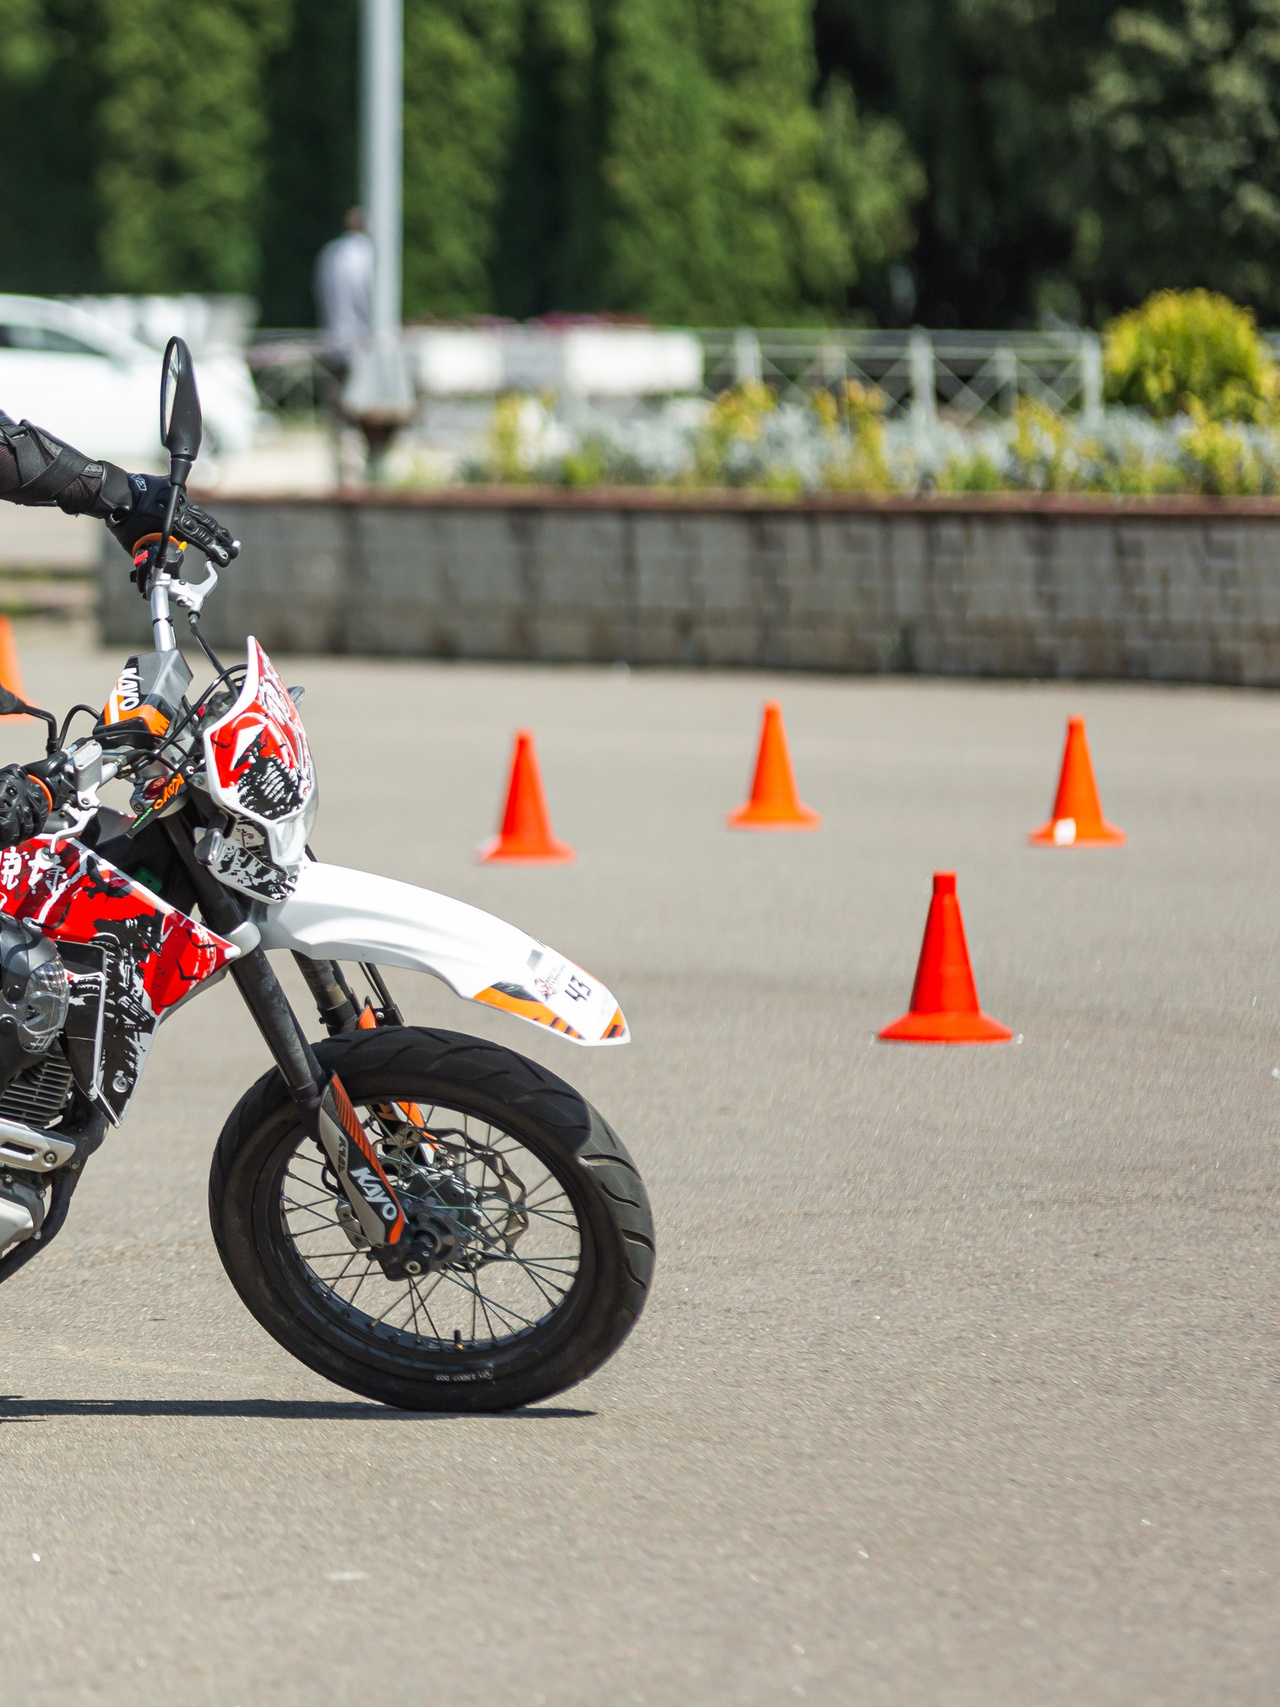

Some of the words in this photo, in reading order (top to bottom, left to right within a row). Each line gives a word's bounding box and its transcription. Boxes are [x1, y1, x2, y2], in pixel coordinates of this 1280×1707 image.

[116, 667, 144, 711] KAYO
[153, 773, 185, 810] KAYO
[564, 975, 592, 1002] 43
[350, 1166, 398, 1221] KAYO
